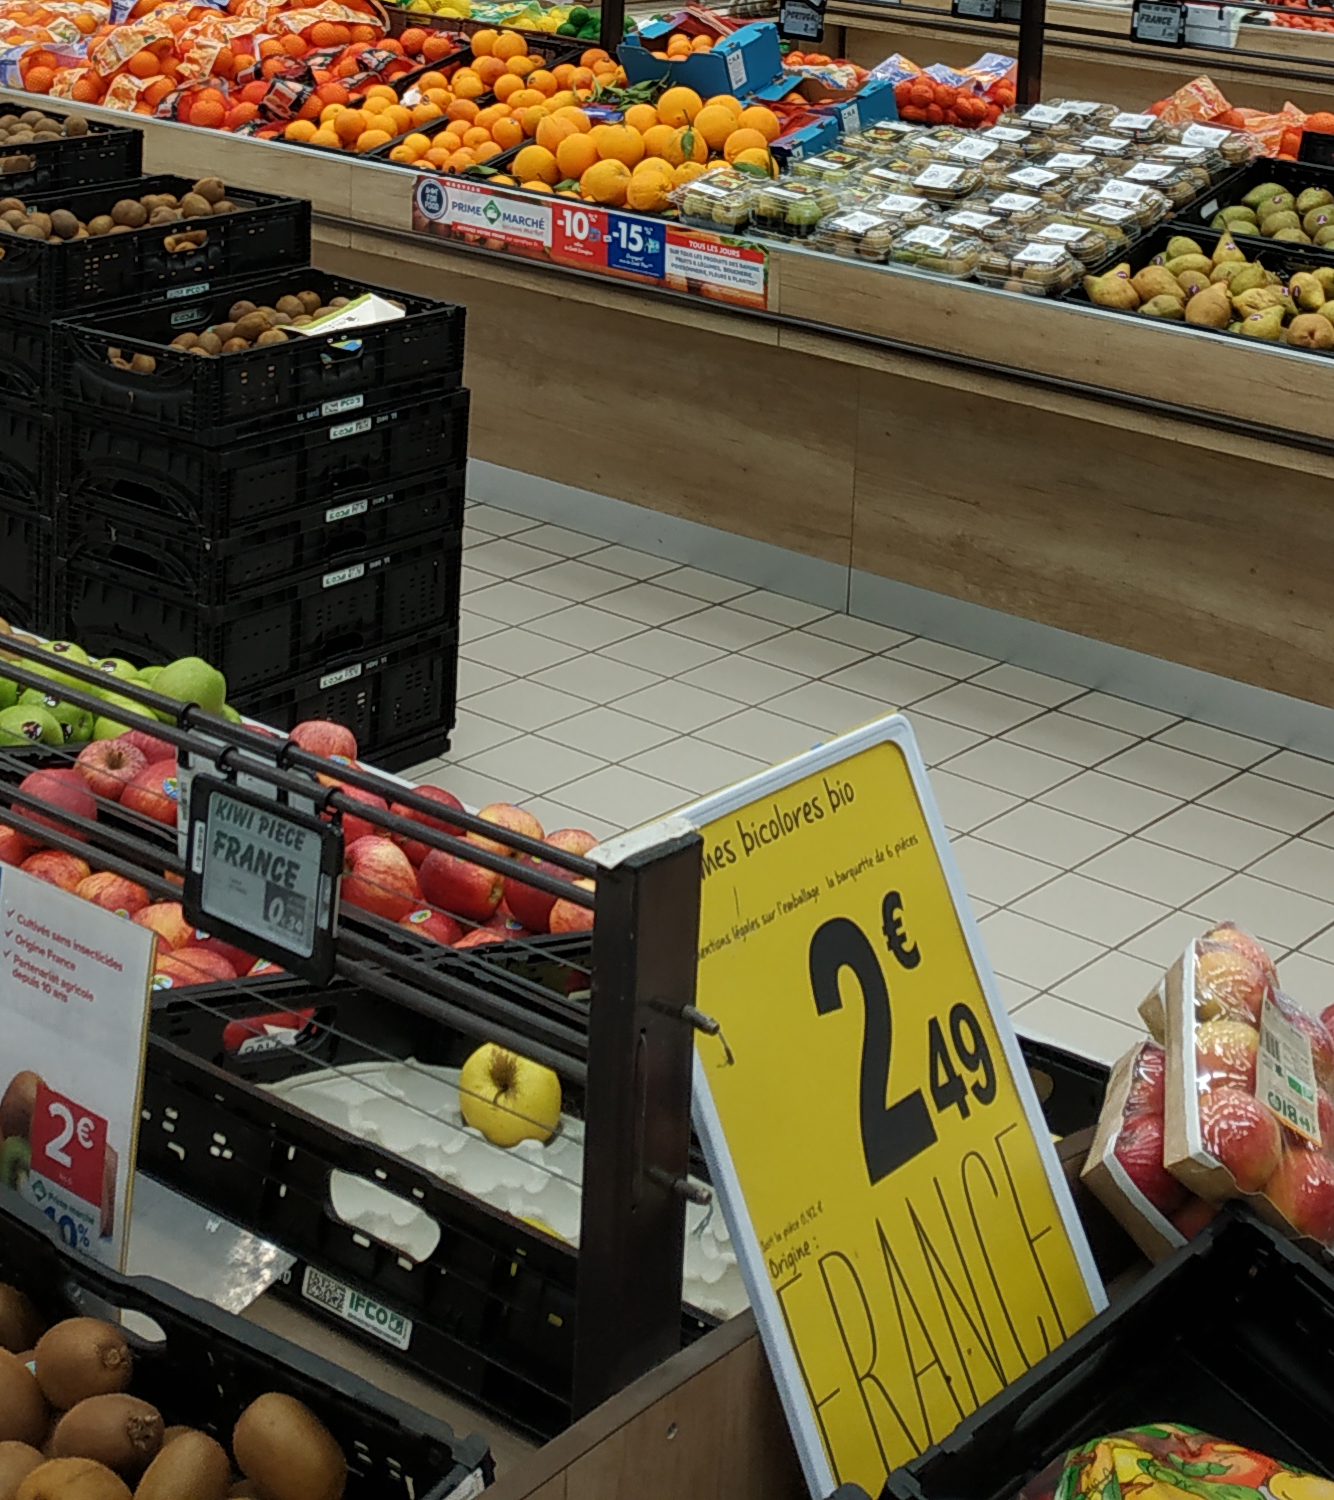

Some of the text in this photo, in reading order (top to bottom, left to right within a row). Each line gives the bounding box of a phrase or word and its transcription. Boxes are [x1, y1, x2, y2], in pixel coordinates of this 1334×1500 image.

[1141, 14, 1172, 26] FRANCE
[451, 201, 482, 216] PRIME
[503, 213, 545, 230] MARCHÉ
[675, 257, 692, 265] FRUITS
[689, 241, 705, 250] TOUS
[719, 246, 740, 257] JOURS
[704, 255, 727, 265] PRODUITS
[216, 800, 306, 851] KIWI PIECE
[737, 778, 854, 857] bicolores bio
[213, 830, 300, 890] FRANCE
[732, 835, 918, 942] légales sur l'emballage la barquette de 6 pièces
[15, 934, 76, 971] Origine France
[18, 913, 123, 972] Cultivés sans insecticides
[12, 968, 68, 1002] depuis 10 ans
[14, 954, 94, 1002] Partenariat agricole
[769, 1241, 811, 1279] Origine
[349, 1292, 388, 1325] IFCO
[776, 1124, 1070, 1489] FRANCE
